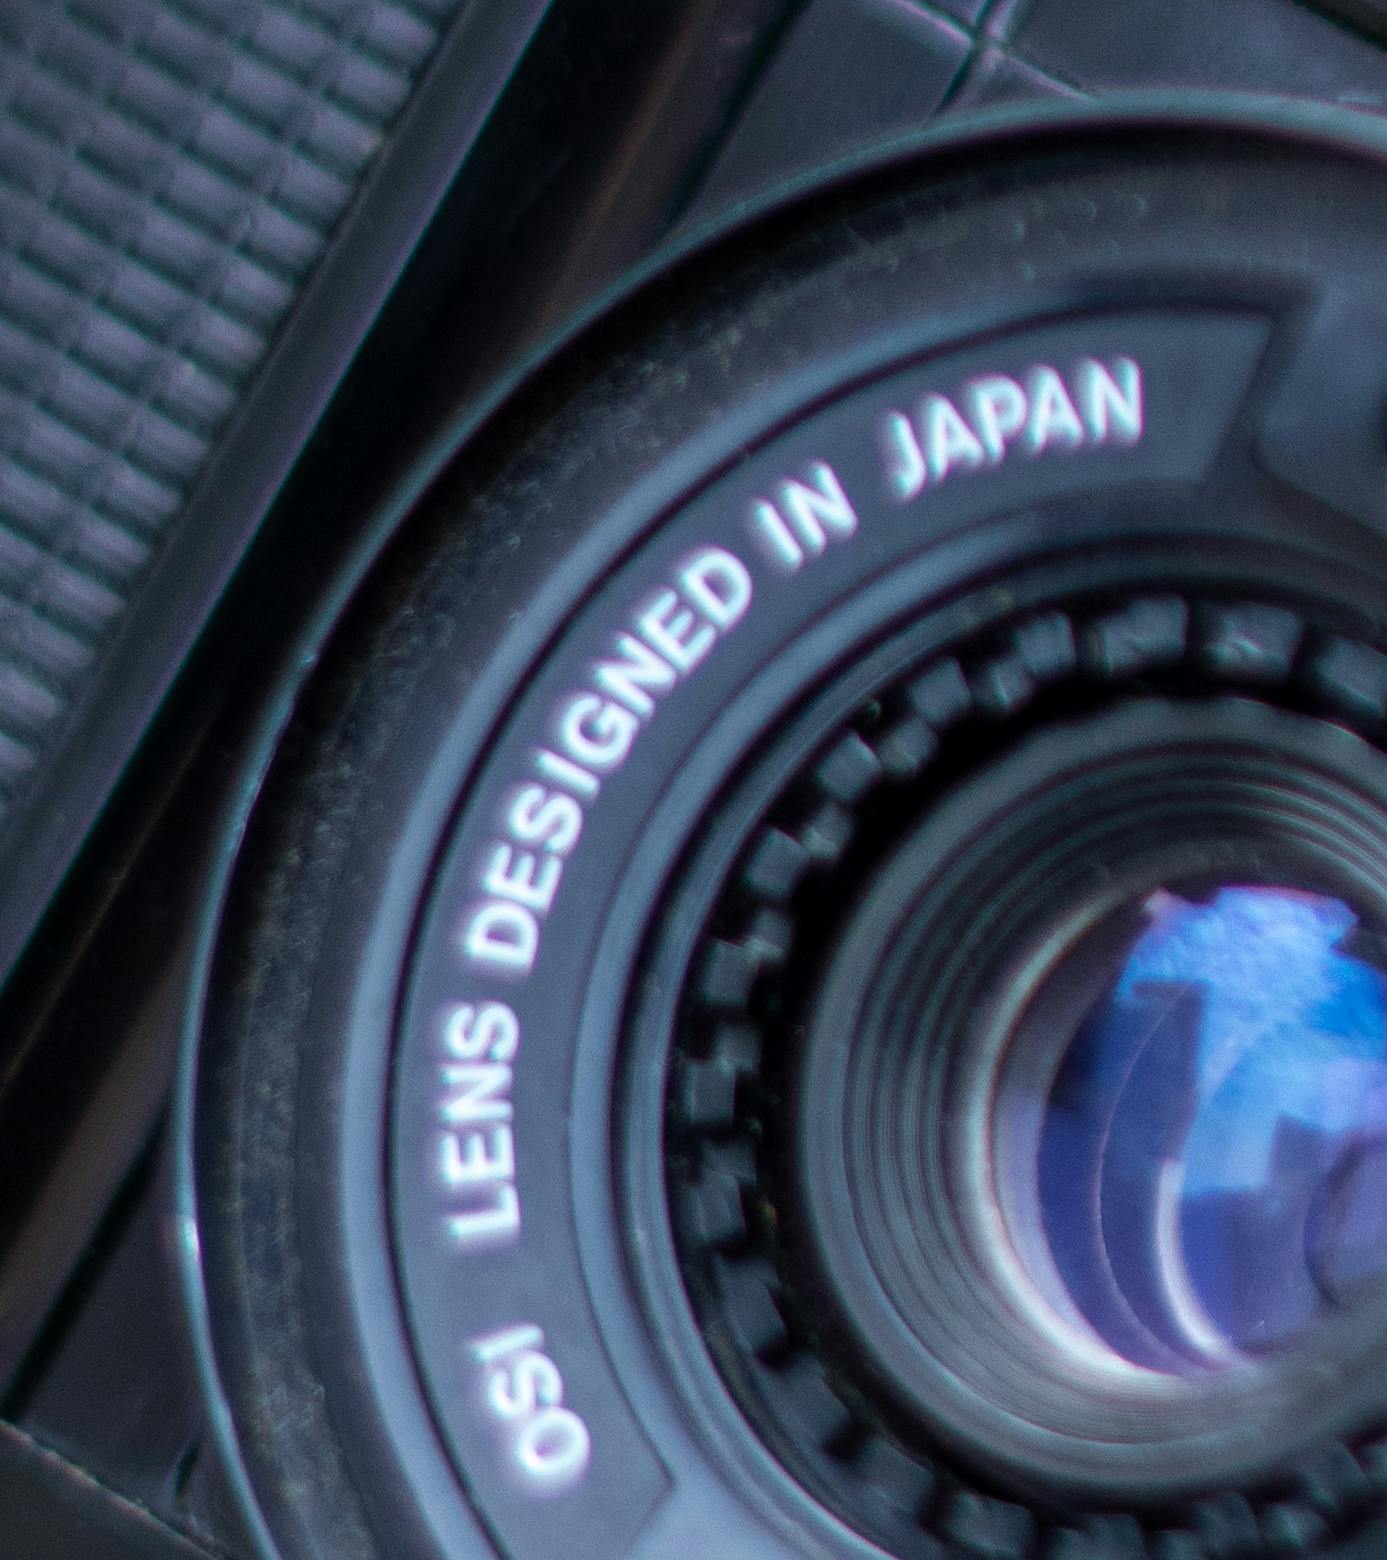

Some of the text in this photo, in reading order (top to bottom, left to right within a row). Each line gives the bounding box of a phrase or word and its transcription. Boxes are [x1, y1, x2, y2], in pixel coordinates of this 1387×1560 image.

[440, 355, 1143, 1246] LENS DESIGNED IN JAPAN
